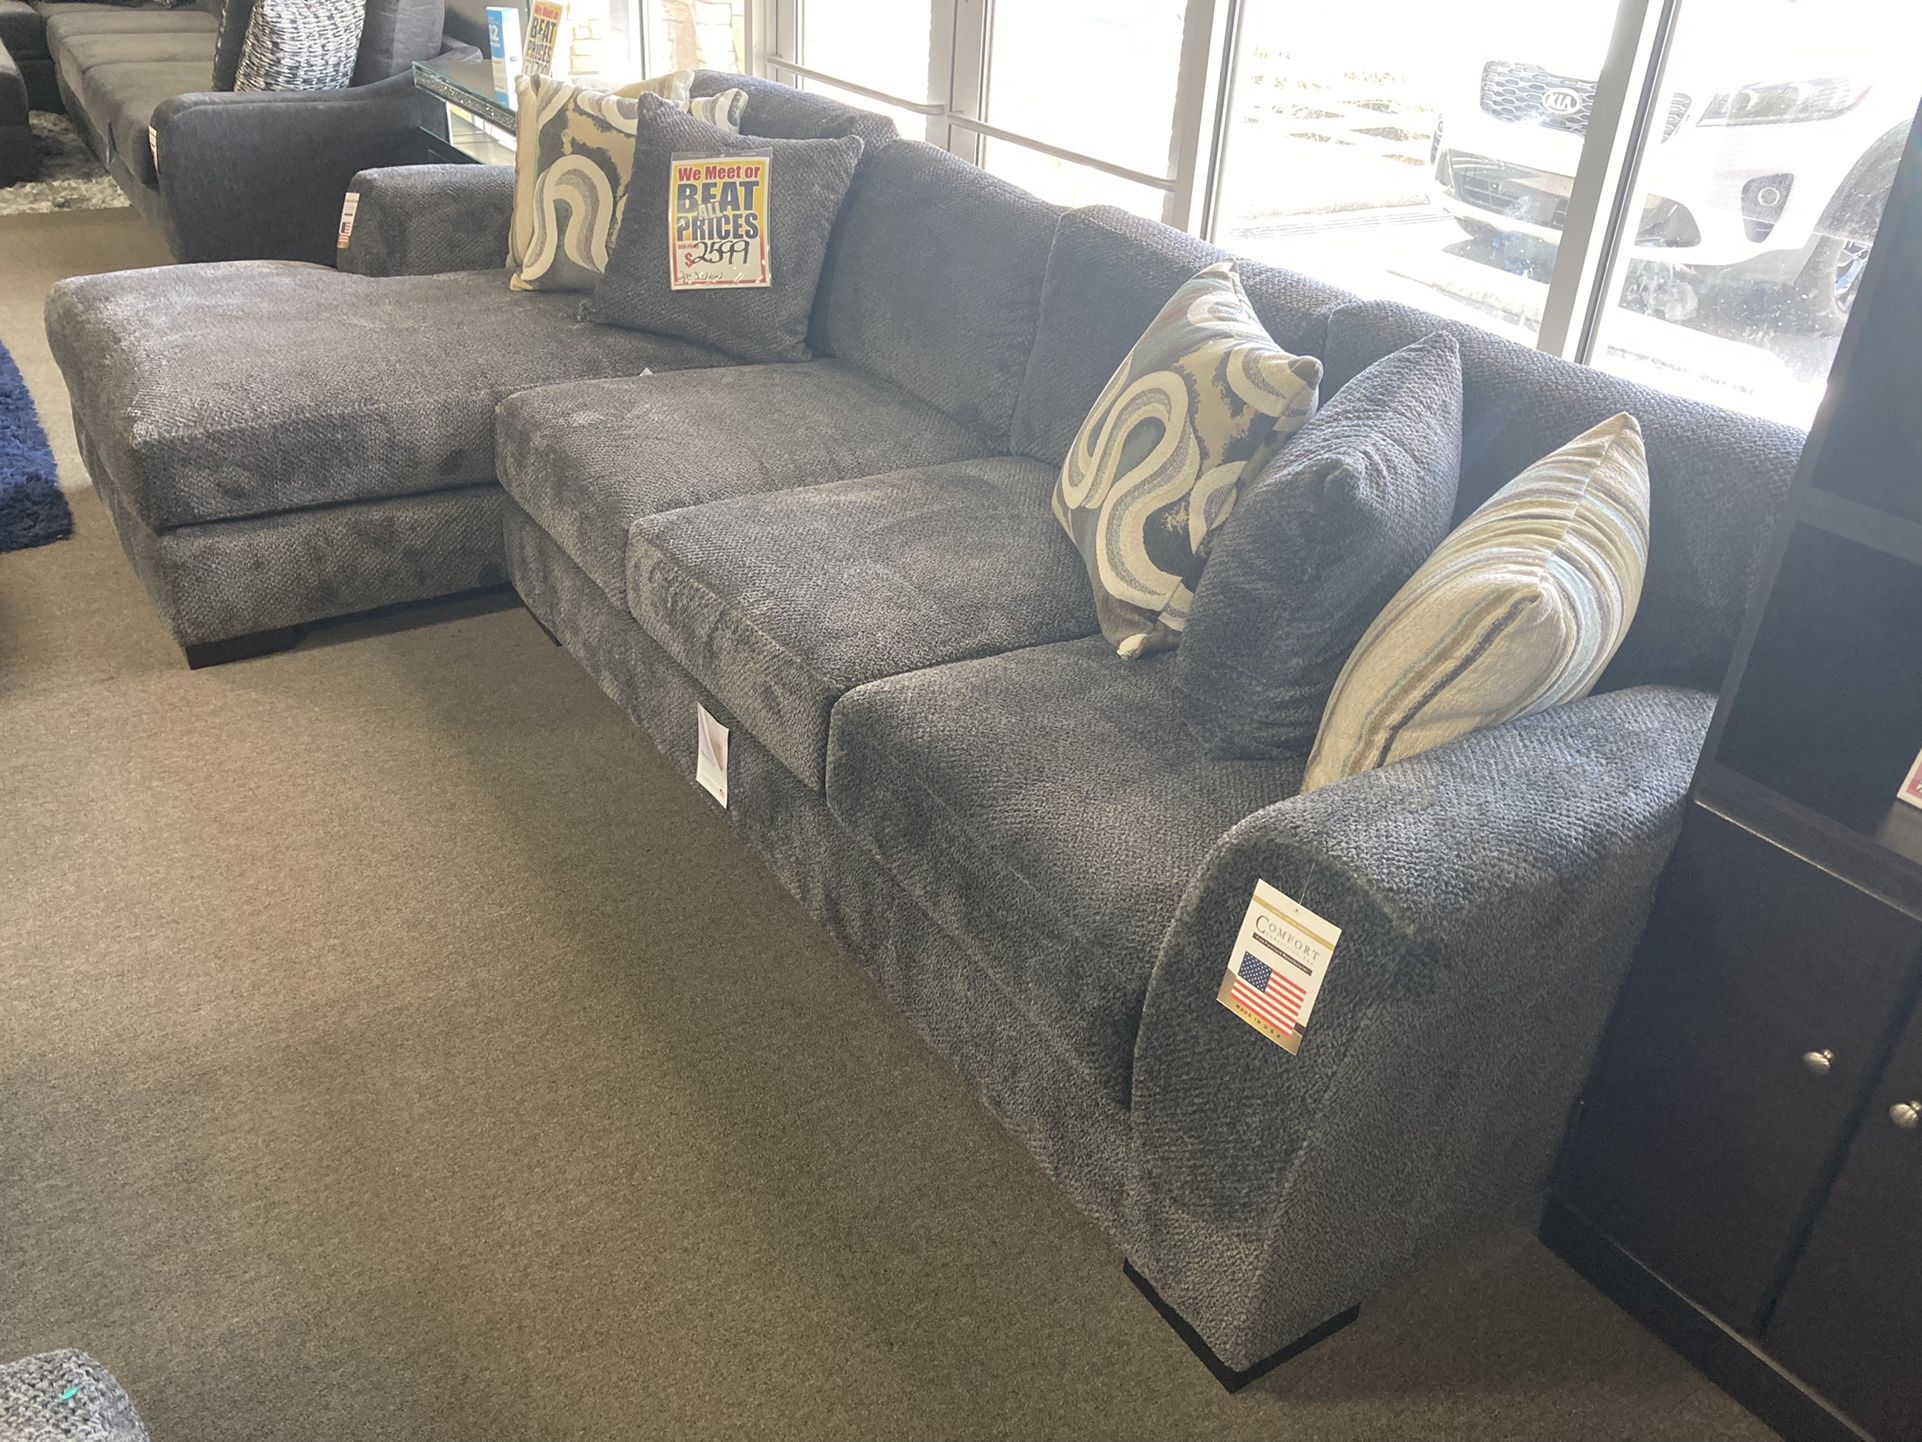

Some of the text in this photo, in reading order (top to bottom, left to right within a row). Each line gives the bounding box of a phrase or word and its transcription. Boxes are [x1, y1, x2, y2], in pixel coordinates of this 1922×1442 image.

[530, 17, 557, 44] BEAT
[526, 40, 552, 63] PRICES
[1546, 90, 1575, 110] KIA
[678, 165, 760, 181] We Meet or
[677, 181, 759, 214] BEAT
[699, 201, 723, 219] ALL
[677, 213, 758, 241] PRICES
[1256, 915, 1320, 960] COMFORT
